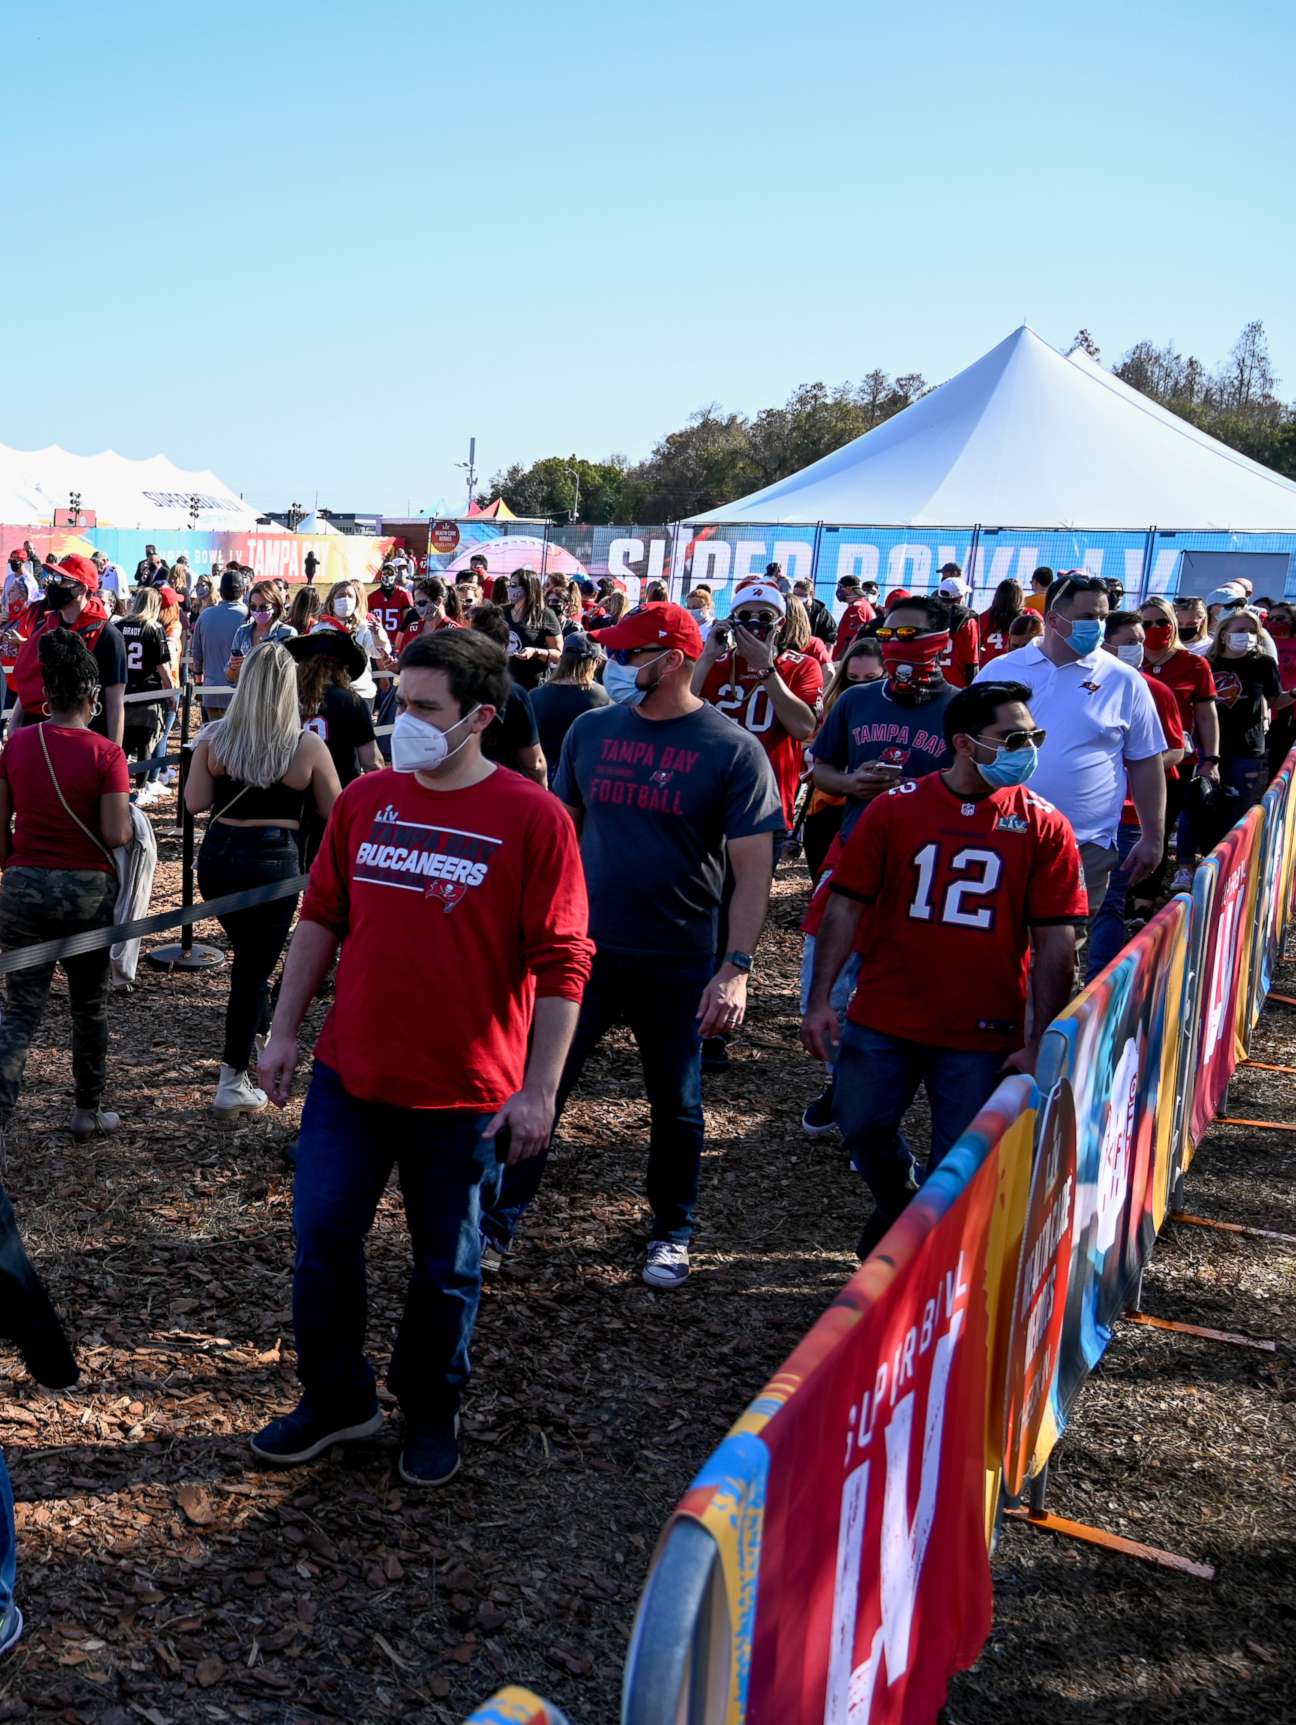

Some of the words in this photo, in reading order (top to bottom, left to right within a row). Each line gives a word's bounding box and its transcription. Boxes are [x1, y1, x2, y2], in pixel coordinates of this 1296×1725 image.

[247, 538, 301, 577] TAMPA
[608, 538, 813, 614] SUPER
[122, 626, 141, 636] BRADY
[714, 683, 774, 732] 20
[601, 739, 656, 768] TAMPA
[659, 746, 700, 774] BAY
[852, 723, 909, 746] TAMPA
[911, 729, 947, 758] BAY
[590, 778, 683, 815] FOOTBALL
[370, 824, 440, 850] TAMPA
[355, 842, 489, 886] BUCCANEERS
[908, 844, 1002, 930] 12
